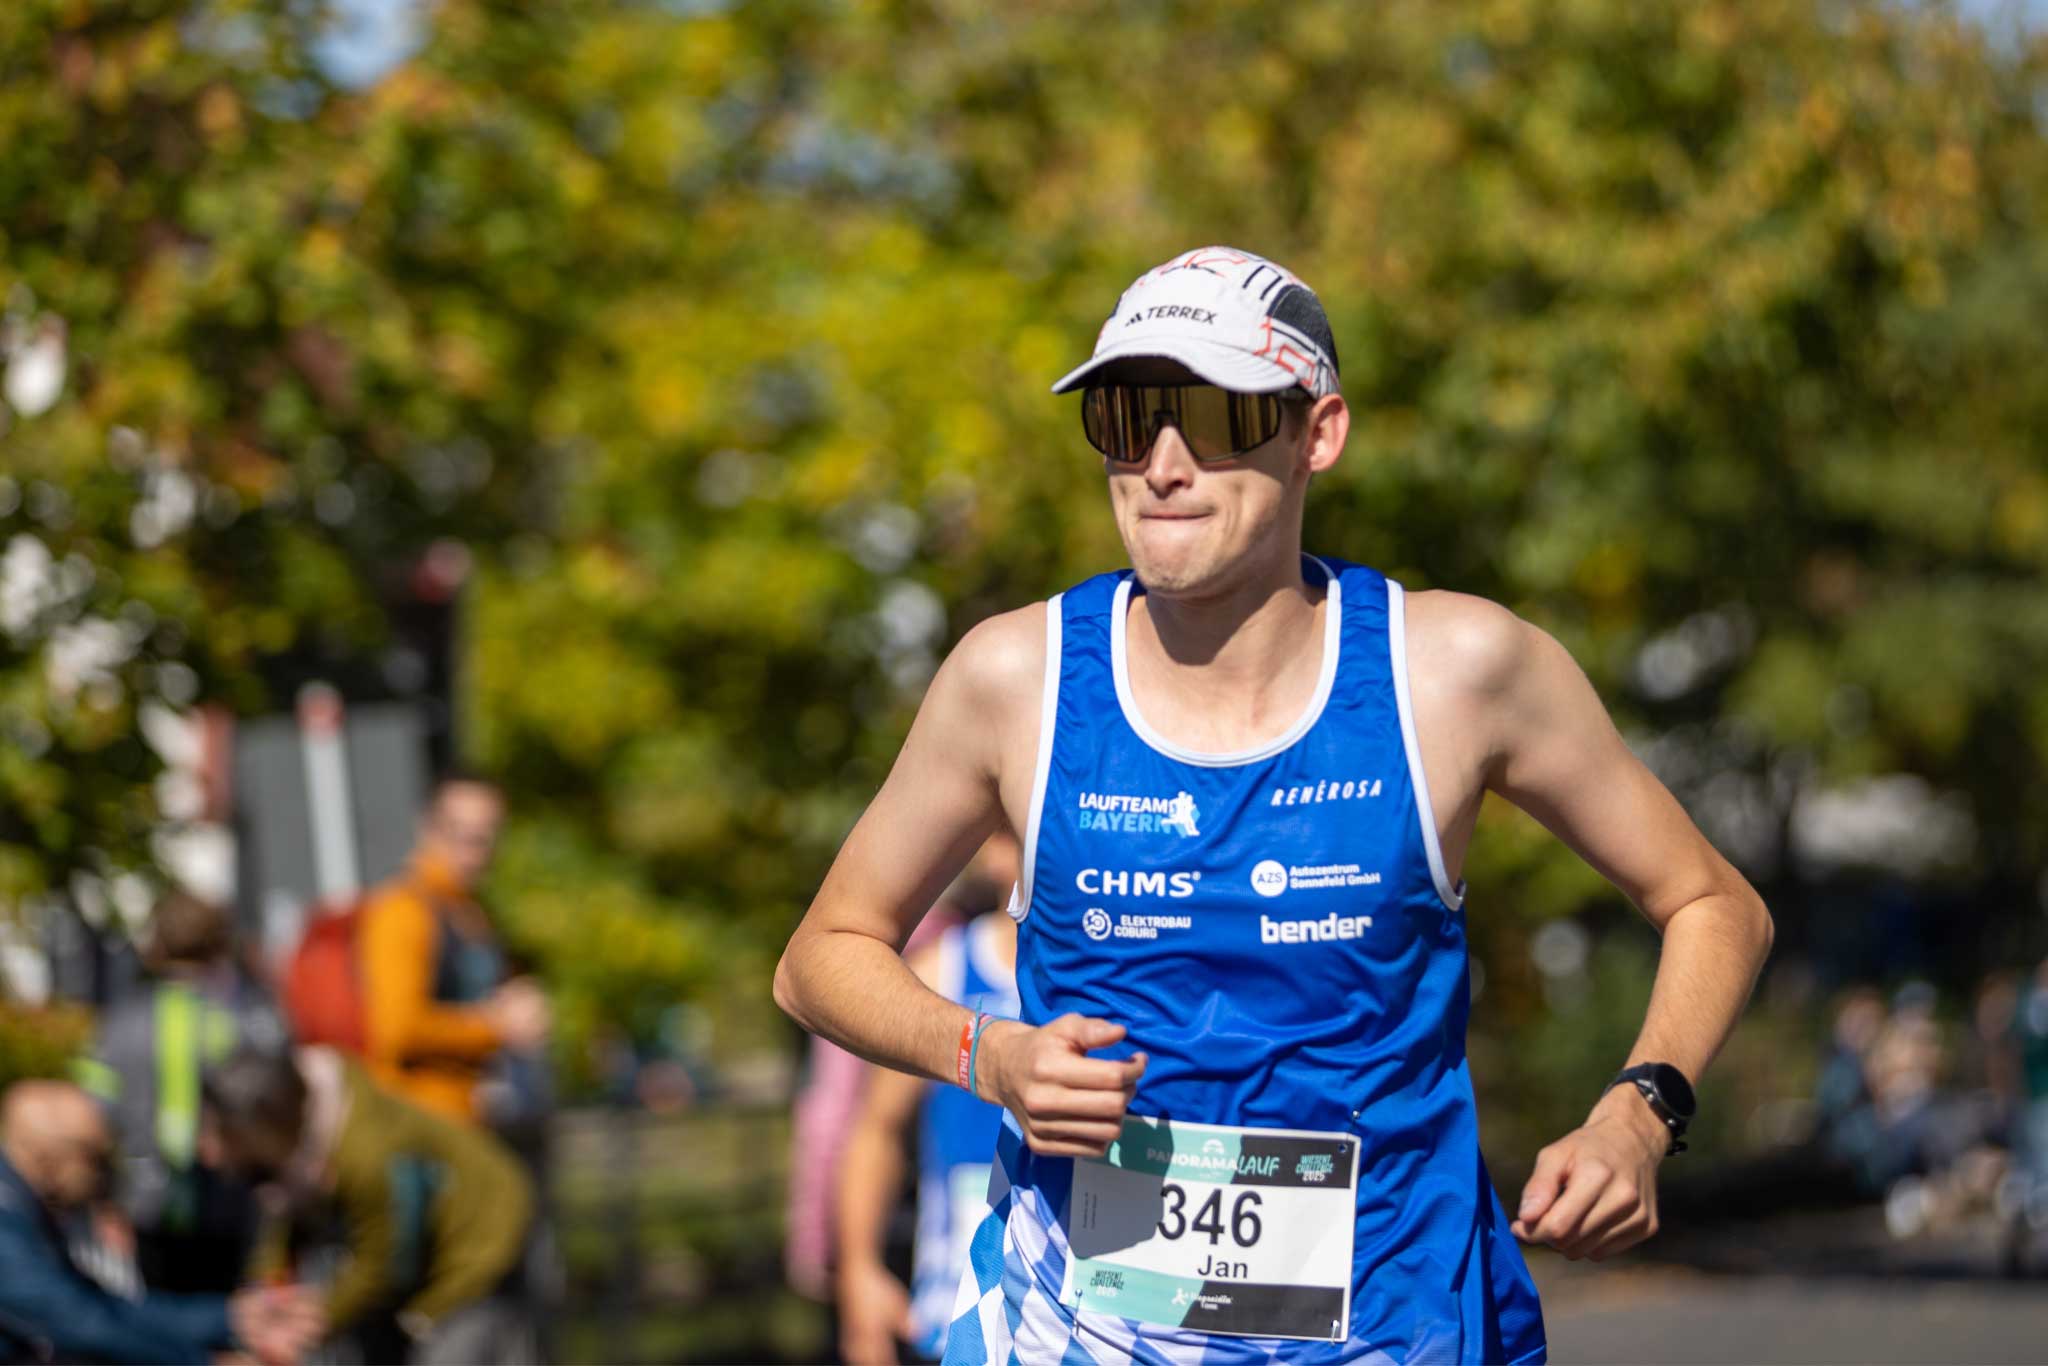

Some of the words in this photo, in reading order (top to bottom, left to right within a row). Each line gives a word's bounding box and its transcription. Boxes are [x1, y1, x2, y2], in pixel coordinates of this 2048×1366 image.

[1147, 305, 1218, 325] TERREX
[1079, 792, 1169, 814] LAUFTEAM
[1079, 810, 1171, 834] BAYERN
[1257, 872, 1283, 884] AZS
[1289, 864, 1360, 877] Autozentrum
[1290, 875, 1346, 889] Sonnefeld
[1347, 872, 1381, 886] GmbH
[1114, 925, 1158, 939] COBURG
[1120, 915, 1192, 929] ELEKTROBAU
[1260, 912, 1372, 944] bender
[1157, 1184, 1262, 1247] 346
[1197, 1254, 1248, 1279] Jan
